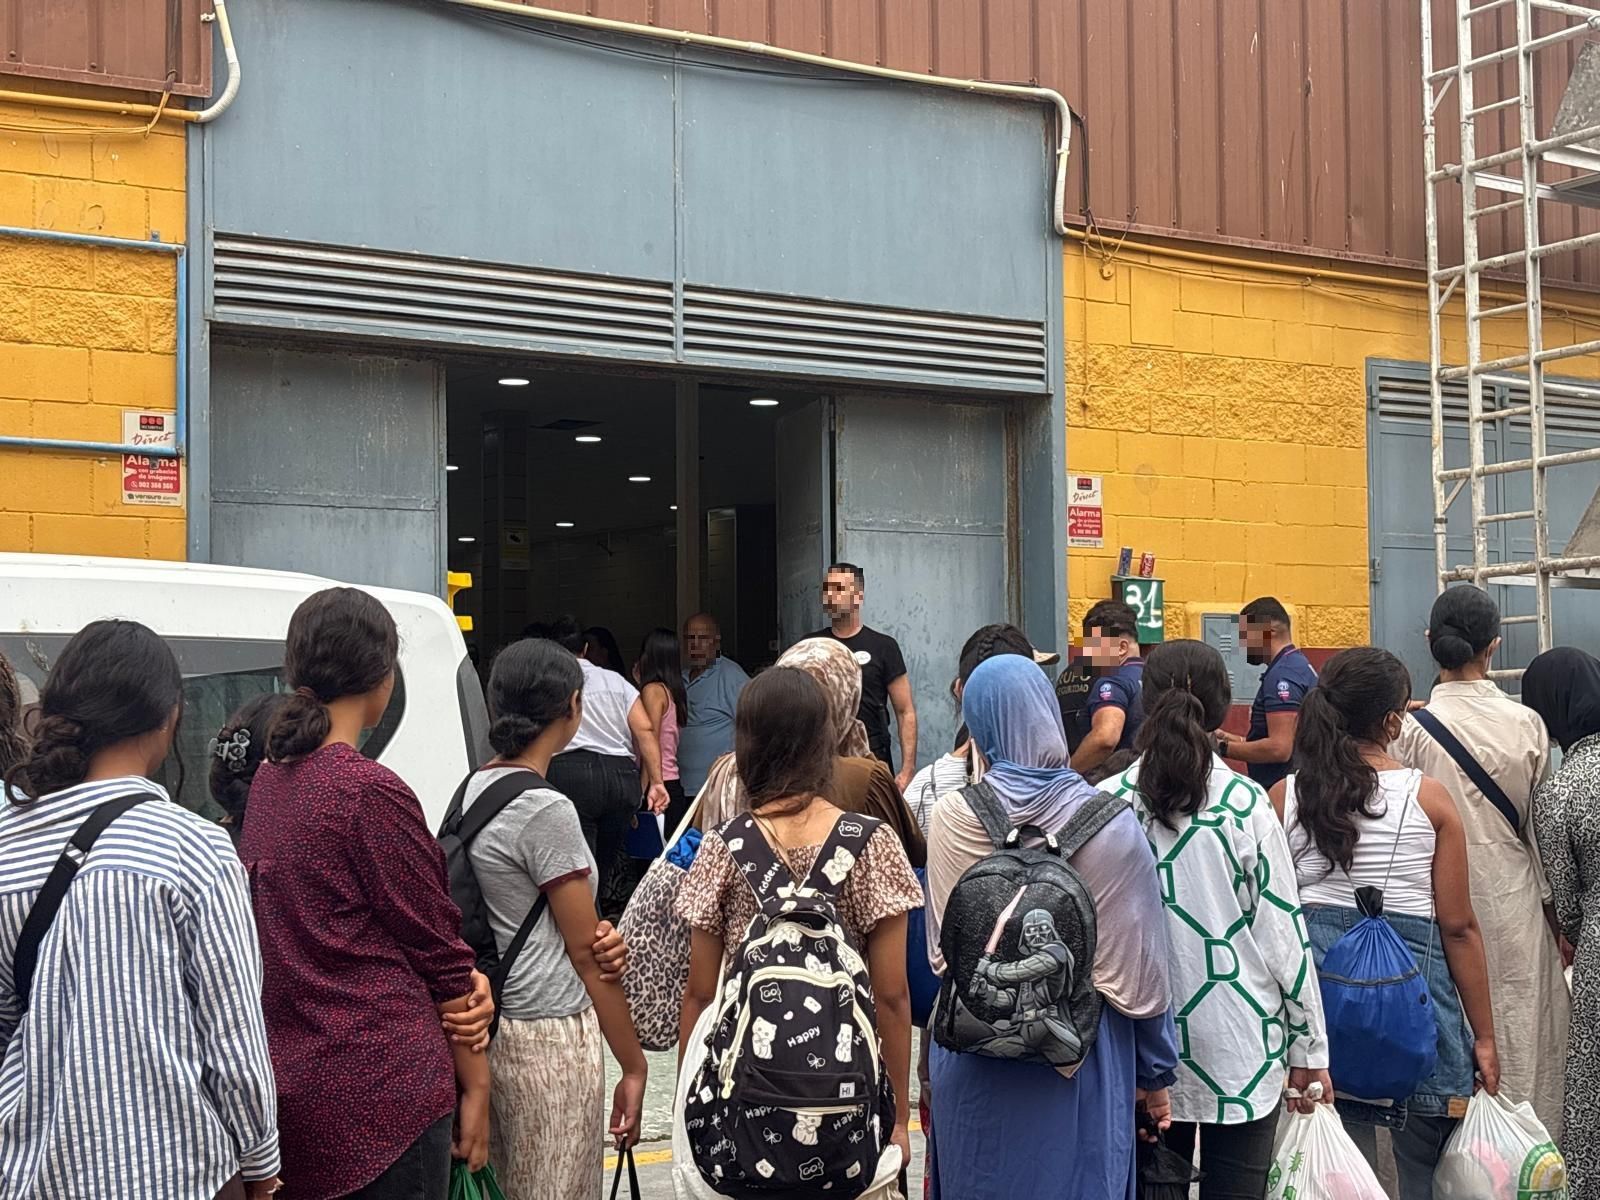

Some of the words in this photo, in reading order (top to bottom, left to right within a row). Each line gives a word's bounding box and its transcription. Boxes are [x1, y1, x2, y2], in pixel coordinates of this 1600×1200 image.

[132, 432, 175, 445] Direct
[127, 455, 178, 467] Alama
[1070, 508, 1101, 518] Alarma
[758, 863, 781, 895] Happy
[787, 1025, 821, 1048] Happy
[841, 1086, 851, 1095] HI
